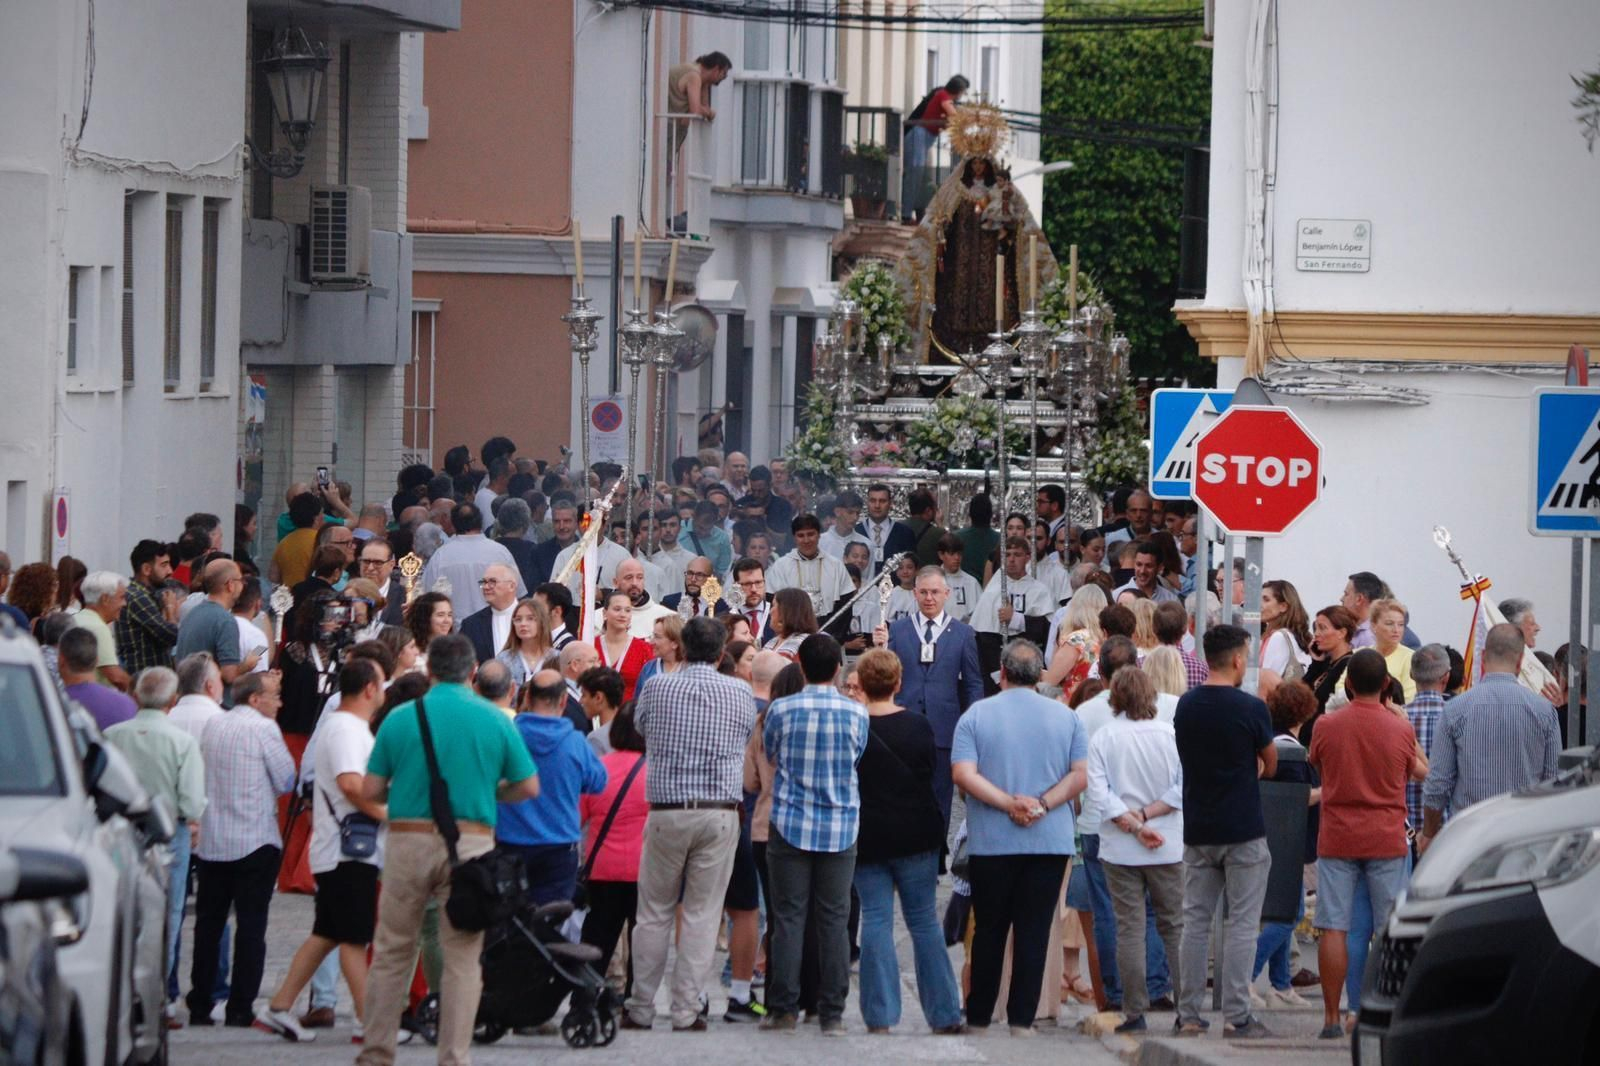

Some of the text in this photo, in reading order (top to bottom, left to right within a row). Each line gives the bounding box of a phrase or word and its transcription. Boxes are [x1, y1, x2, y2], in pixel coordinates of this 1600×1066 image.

[1302, 227, 1323, 235] Calle
[1302, 242, 1363, 252] Benjamín López
[1304, 260, 1362, 269] San Fernando
[1200, 453, 1312, 487] STOP
